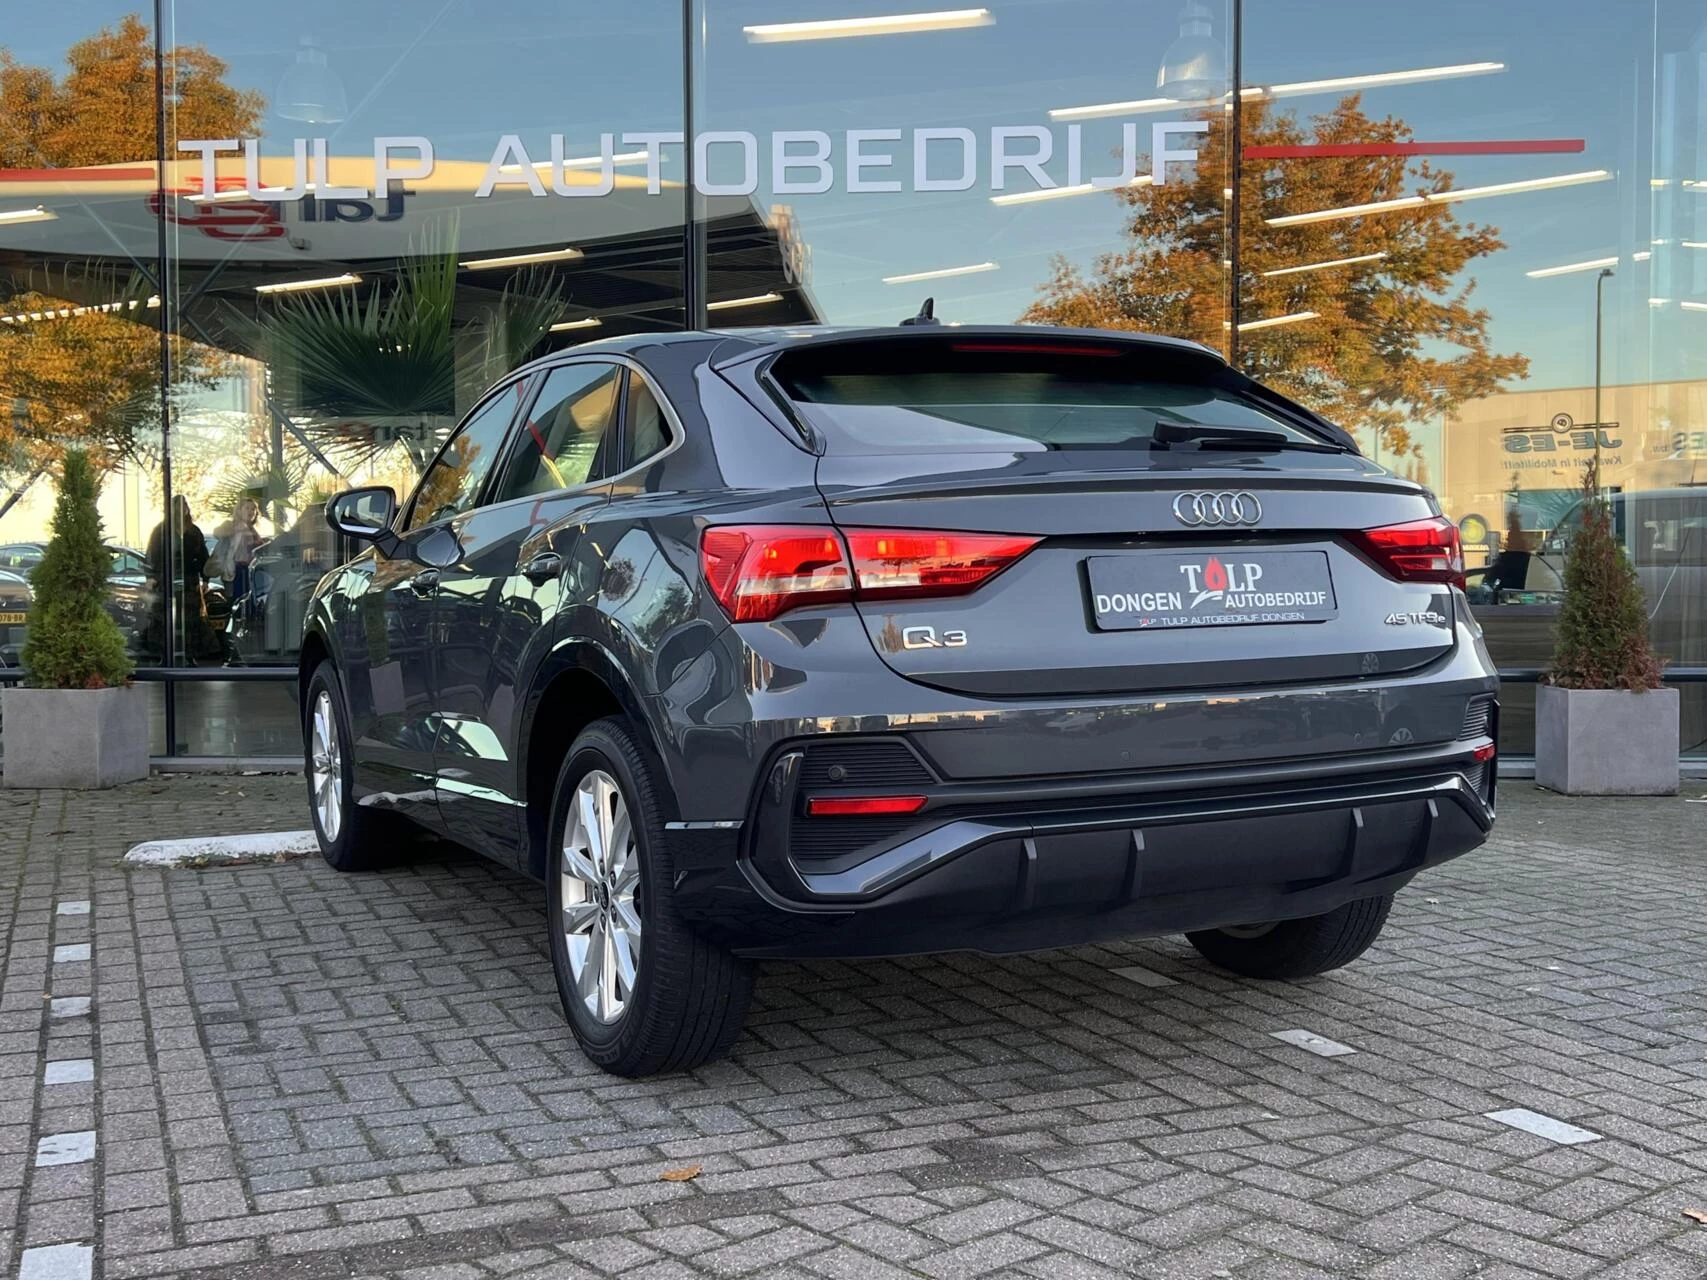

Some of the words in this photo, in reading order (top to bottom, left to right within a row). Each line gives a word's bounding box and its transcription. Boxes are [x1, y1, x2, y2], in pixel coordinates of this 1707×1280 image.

[177, 136, 434, 200] TULP
[475, 120, 1209, 198] AUTOBEDRIJF
[1097, 592, 1182, 613] DONGEN
[1225, 591, 1327, 608] AUTOBEDRIJF
[1162, 617, 1188, 625] TULP
[1191, 614, 1259, 624] AUTOBEDRIJF
[1262, 612, 1305, 621] DONGEN
[1385, 613, 1407, 625] 45
[902, 626, 968, 649] Q3
